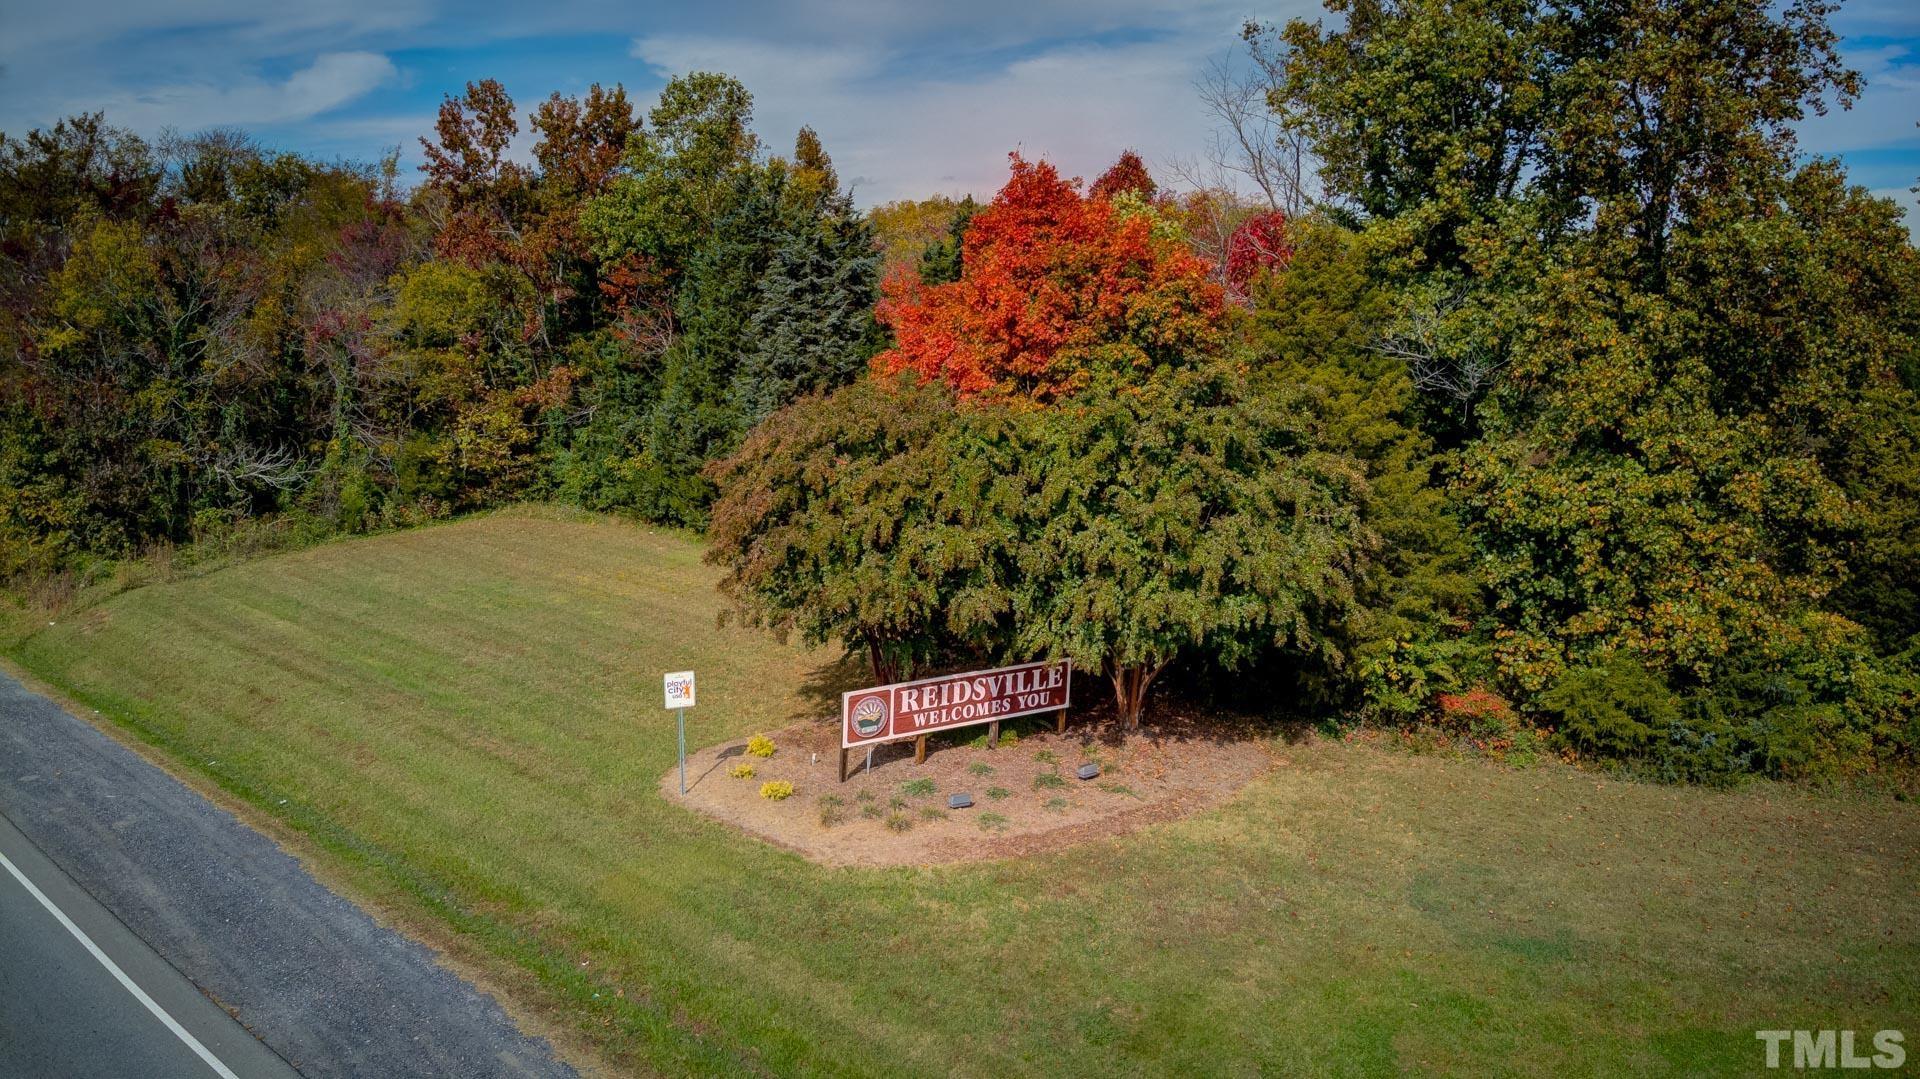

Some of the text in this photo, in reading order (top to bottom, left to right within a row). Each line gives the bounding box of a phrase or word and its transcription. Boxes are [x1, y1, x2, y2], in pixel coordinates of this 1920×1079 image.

[667, 679, 692, 688] playful
[668, 686, 684, 695] city
[900, 666, 1064, 713] REIDSVILLE
[913, 697, 1011, 727] WELCOMES
[1017, 691, 1051, 710] YOU
